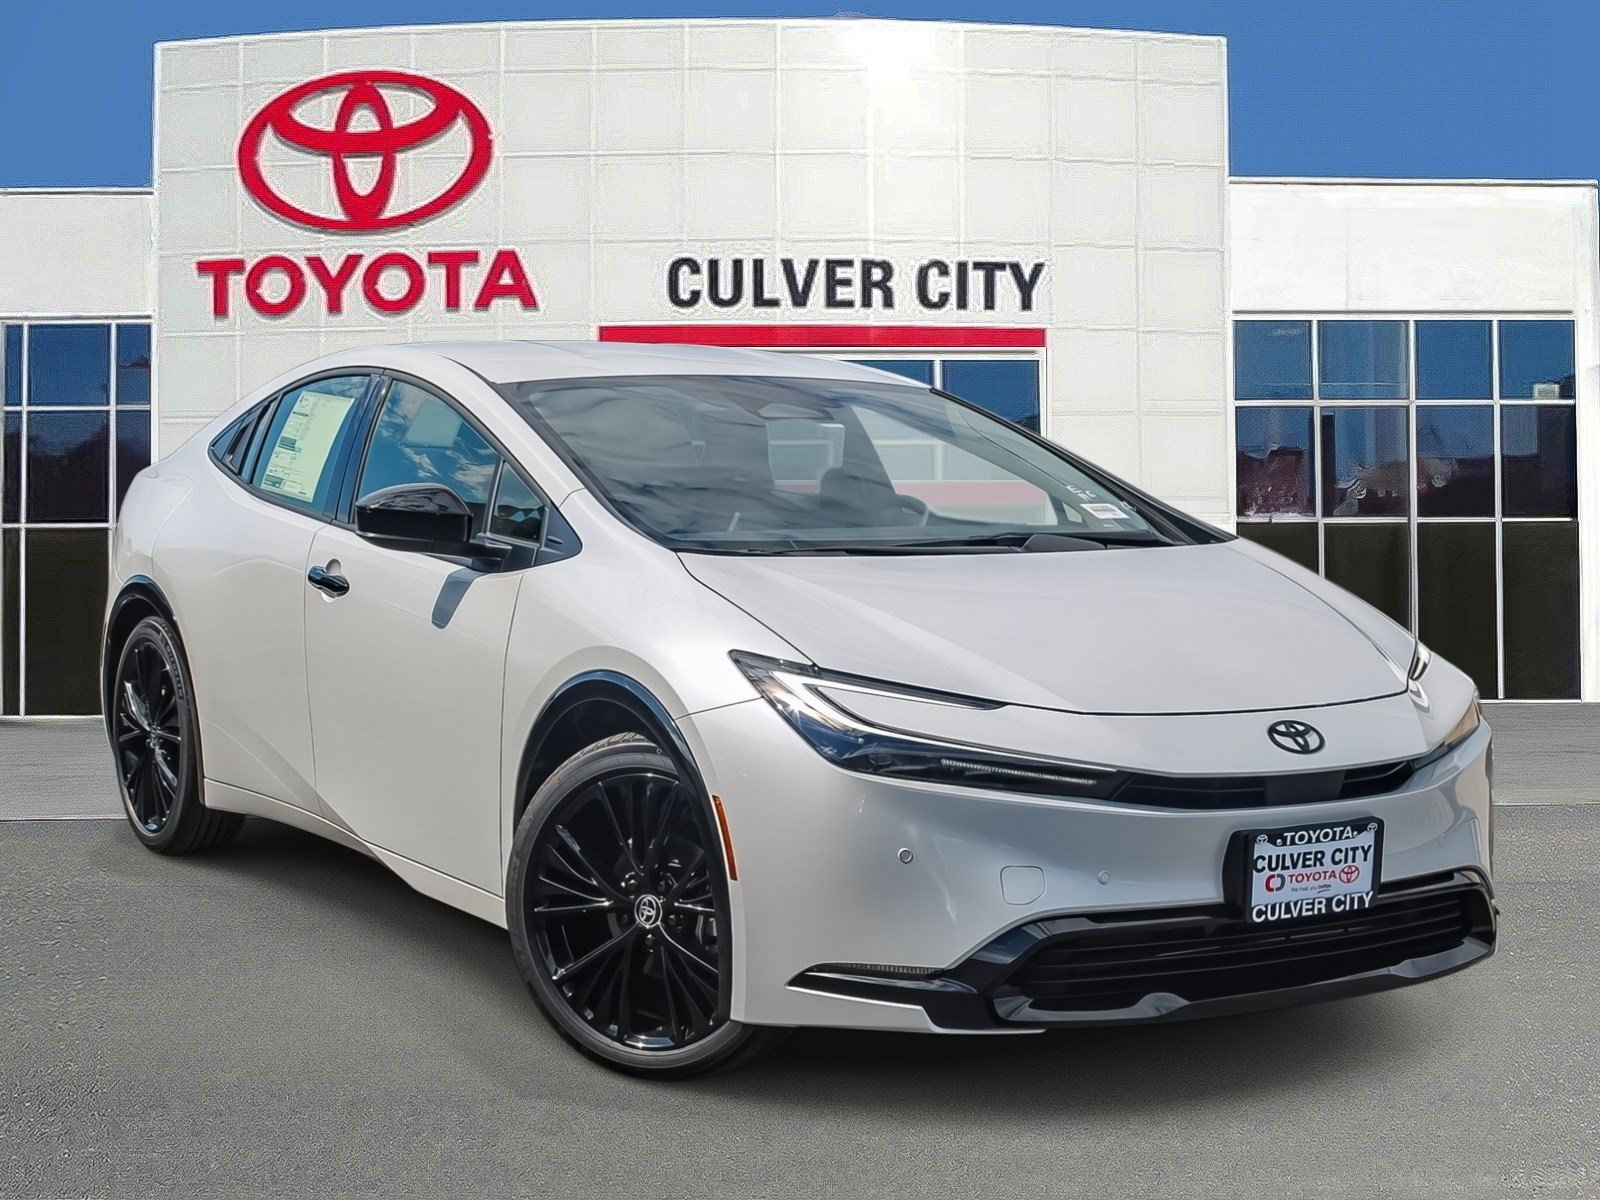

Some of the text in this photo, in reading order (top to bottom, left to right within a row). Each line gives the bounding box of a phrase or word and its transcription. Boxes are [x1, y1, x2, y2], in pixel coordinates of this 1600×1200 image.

[196, 250, 539, 319] TOYOTA
[667, 257, 1045, 311] CULVER CITY
[1283, 826, 1353, 846] TOYOTA
[1253, 844, 1372, 873] CULVER CITY
[1288, 870, 1337, 884] TOYOTA
[1252, 890, 1373, 922] CULVER CITY
